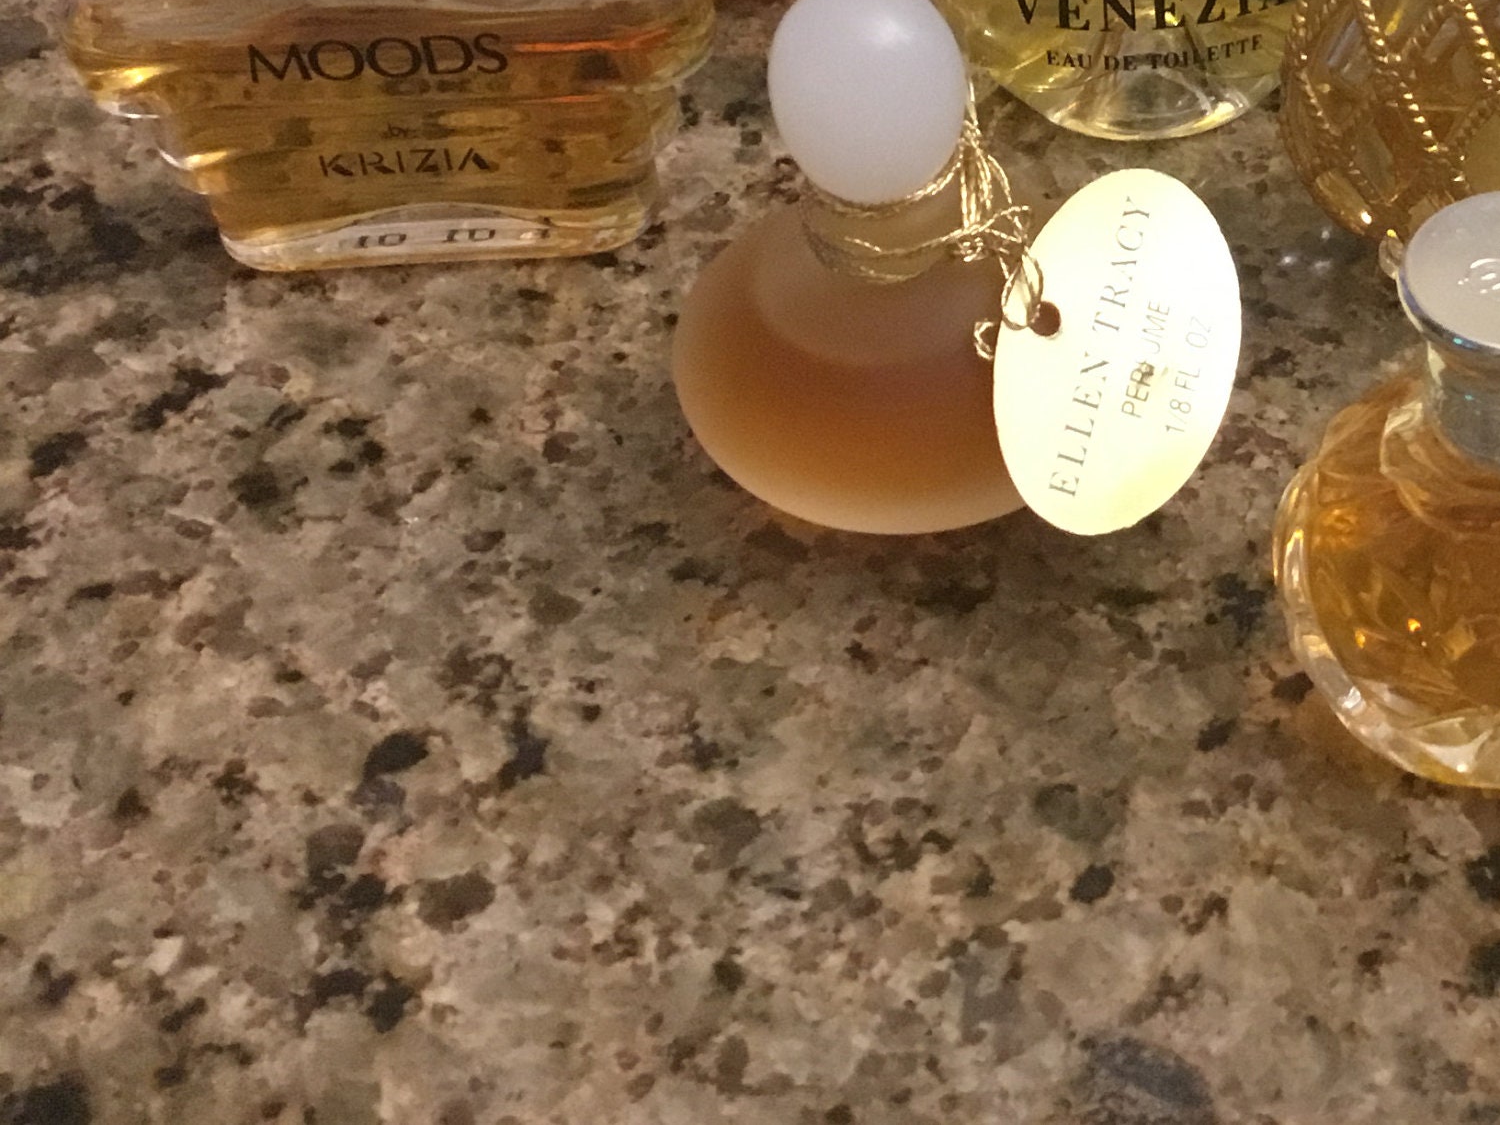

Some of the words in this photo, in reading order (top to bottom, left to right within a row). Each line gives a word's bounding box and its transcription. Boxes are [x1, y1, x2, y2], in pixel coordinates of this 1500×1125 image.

[248, 33, 508, 84] MOODS
[1046, 49, 1092, 70] EAU
[1103, 54, 1138, 71] DE
[1149, 34, 1263, 70] TOILETTE
[318, 147, 492, 177] KRIZIA
[1048, 351, 1109, 497] ELLEN
[1091, 195, 1151, 331] TRACY
[1174, 366, 1201, 392] FL
[1165, 398, 1192, 434] 1/8
